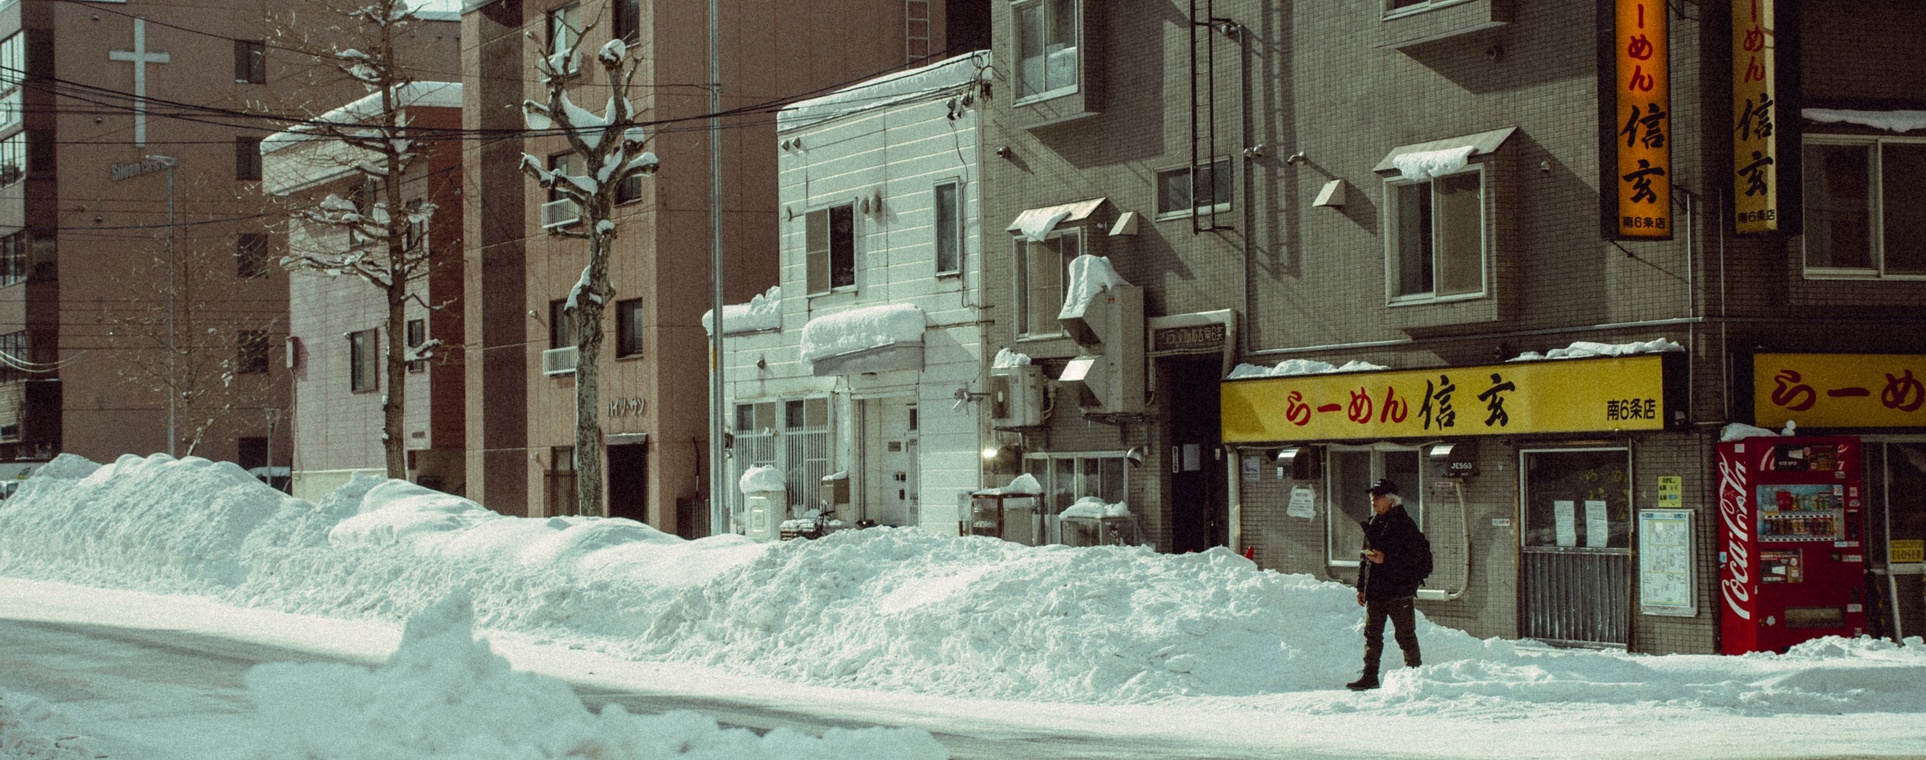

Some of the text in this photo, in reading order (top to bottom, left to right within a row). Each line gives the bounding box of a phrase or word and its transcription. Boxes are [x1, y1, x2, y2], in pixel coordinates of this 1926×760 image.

[1622, 216, 1666, 229] 南6条店
[1738, 209, 1776, 224] 南6条店
[1771, 369, 1926, 412] らーめ
[1607, 398, 1656, 421] 南6条店
[1719, 451, 1751, 620] Coca-Cola
